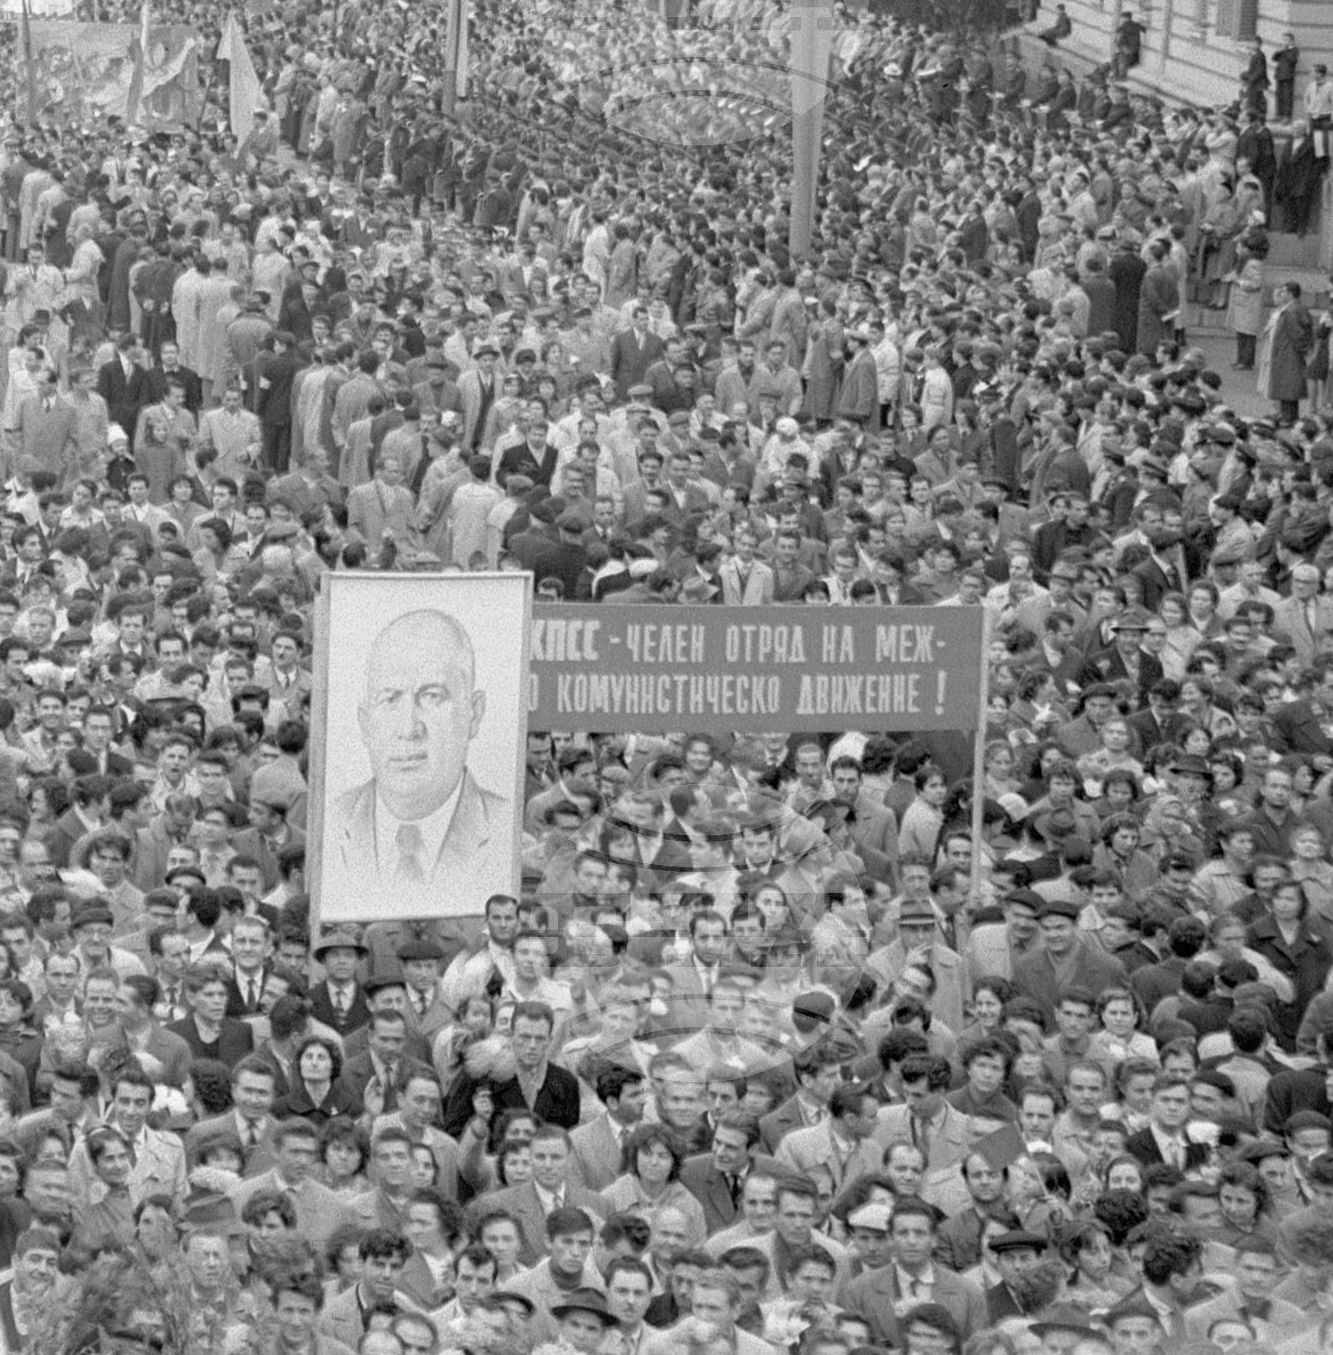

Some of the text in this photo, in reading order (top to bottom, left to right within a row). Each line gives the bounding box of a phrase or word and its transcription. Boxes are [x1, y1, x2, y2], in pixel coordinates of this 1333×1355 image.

[725, 624, 806, 664] ОТРЯД
[822, 625, 854, 663] НА
[557, 673, 780, 714] КОМУНИСТИЧЕСКО
